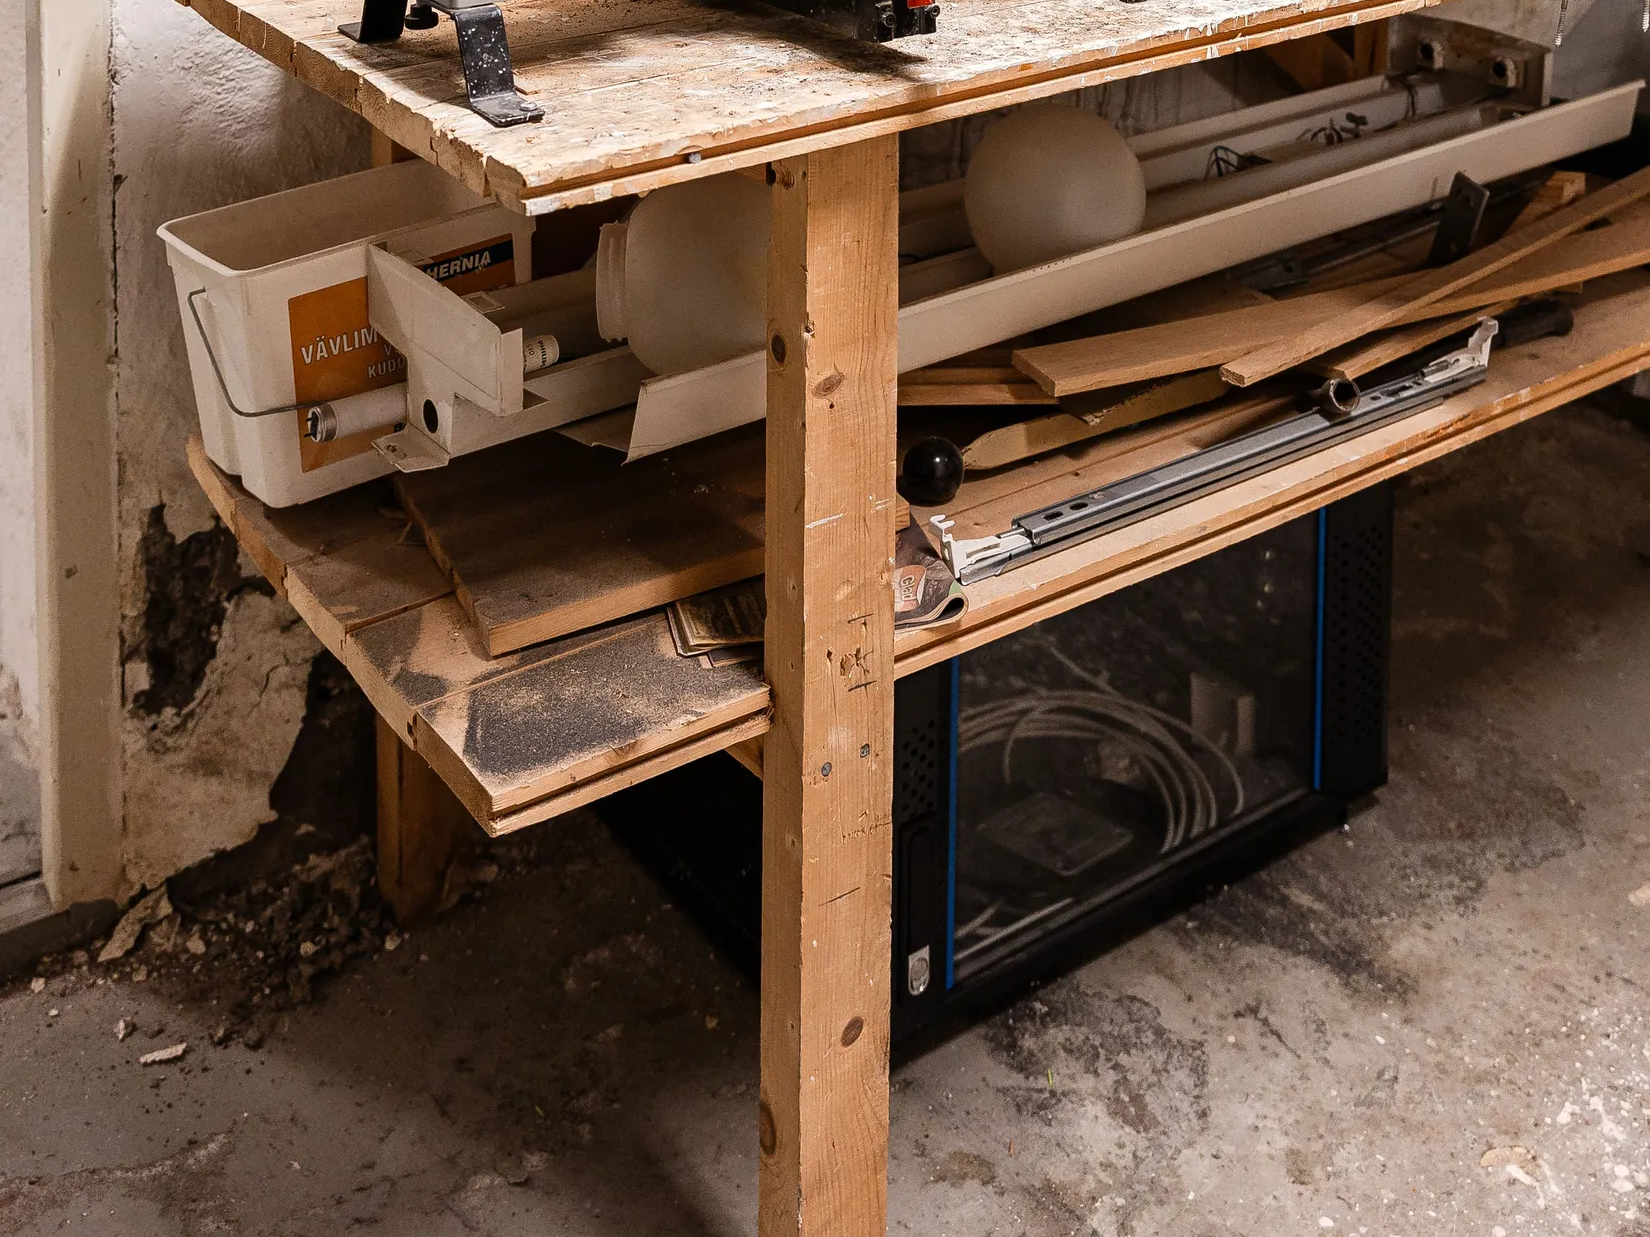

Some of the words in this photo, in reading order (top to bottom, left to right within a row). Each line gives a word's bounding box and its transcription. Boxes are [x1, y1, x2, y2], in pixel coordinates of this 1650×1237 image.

[425, 250, 491, 280] HERNIA
[300, 326, 378, 365] VÄVLIM
[900, 575, 917, 601] Glad
